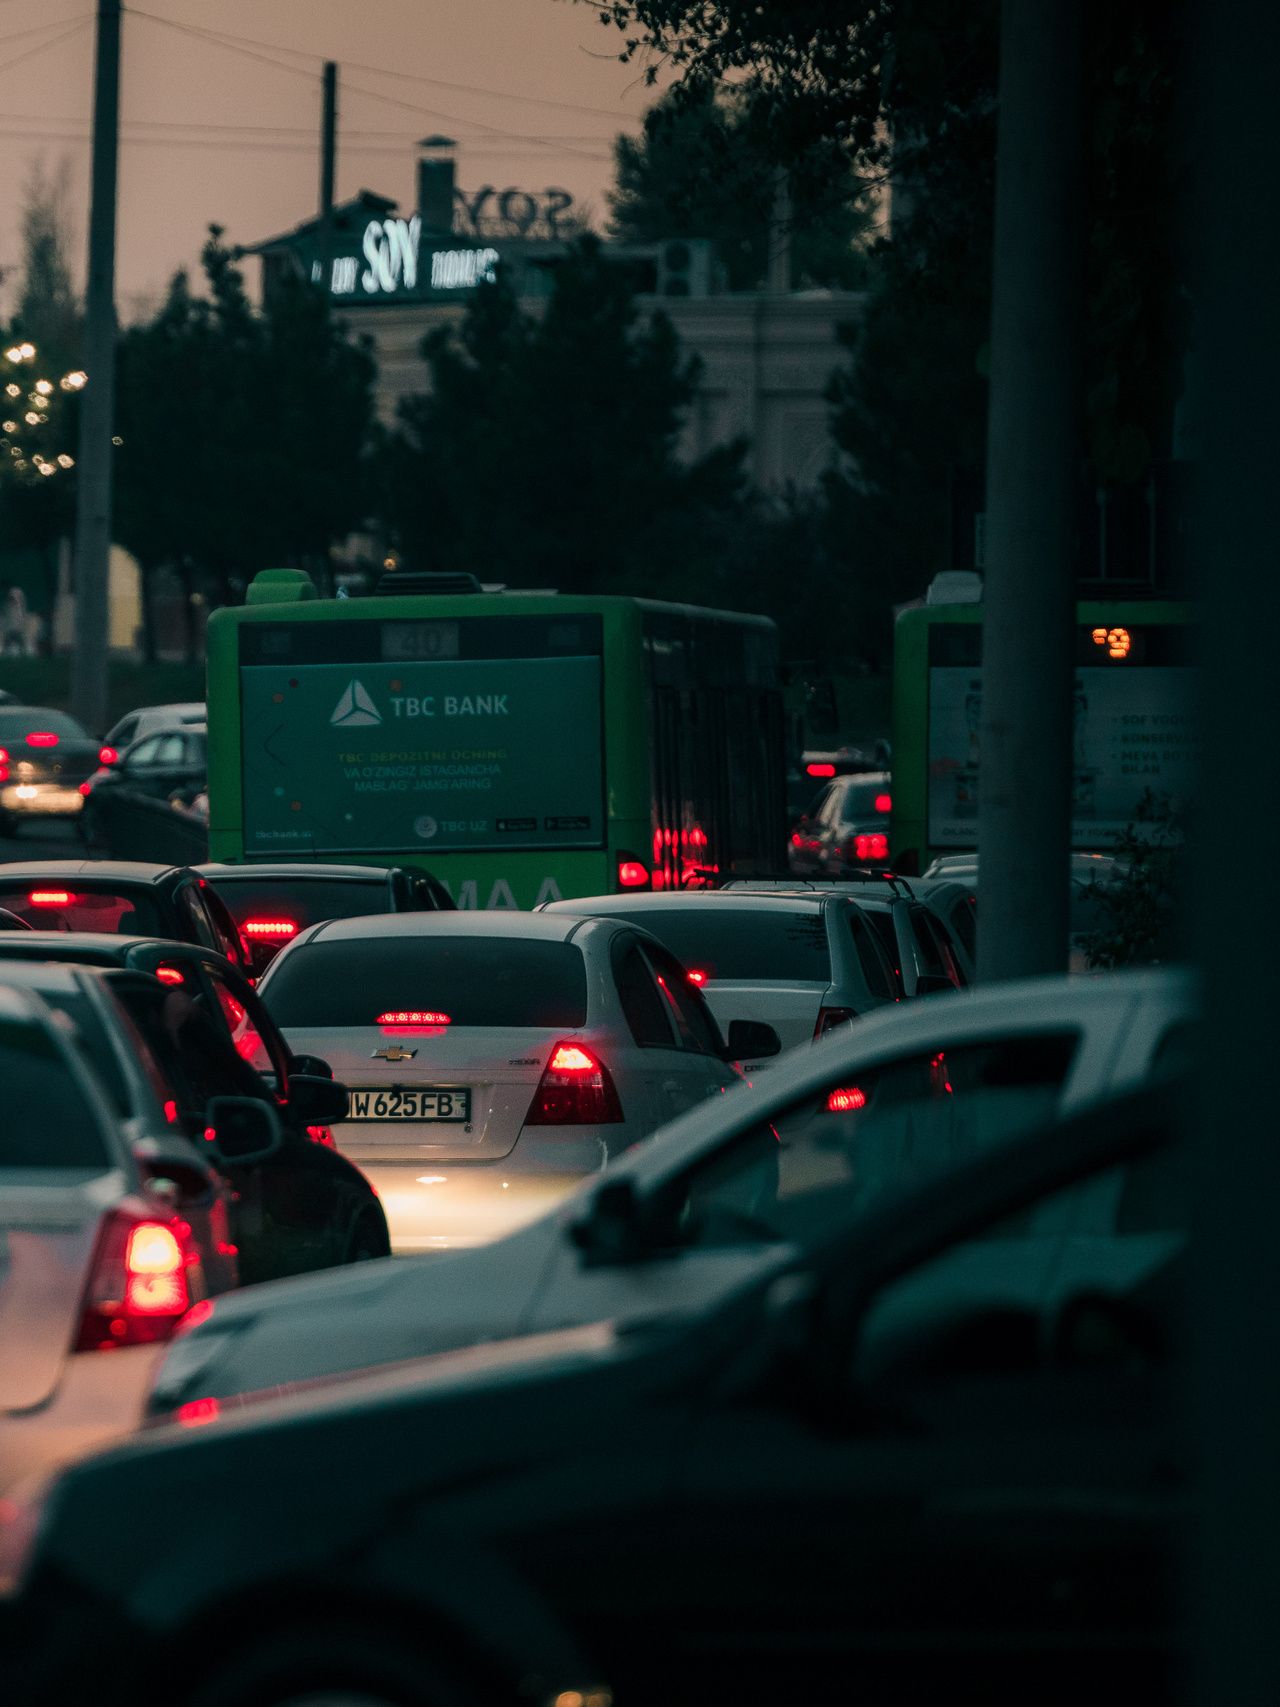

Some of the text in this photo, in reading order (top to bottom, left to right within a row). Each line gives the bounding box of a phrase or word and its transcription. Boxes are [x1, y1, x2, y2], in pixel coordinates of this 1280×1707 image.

[401, 628, 441, 657] 40
[389, 694, 509, 718] TBC BANK
[338, 752, 365, 764] TBC
[451, 748, 508, 761] OCHING
[343, 767, 360, 779] VA
[420, 763, 502, 777] ISTAGANCHA
[441, 820, 488, 832] TBC UZ
[373, 1093, 418, 1117] 625
[421, 1093, 454, 1117] FB
